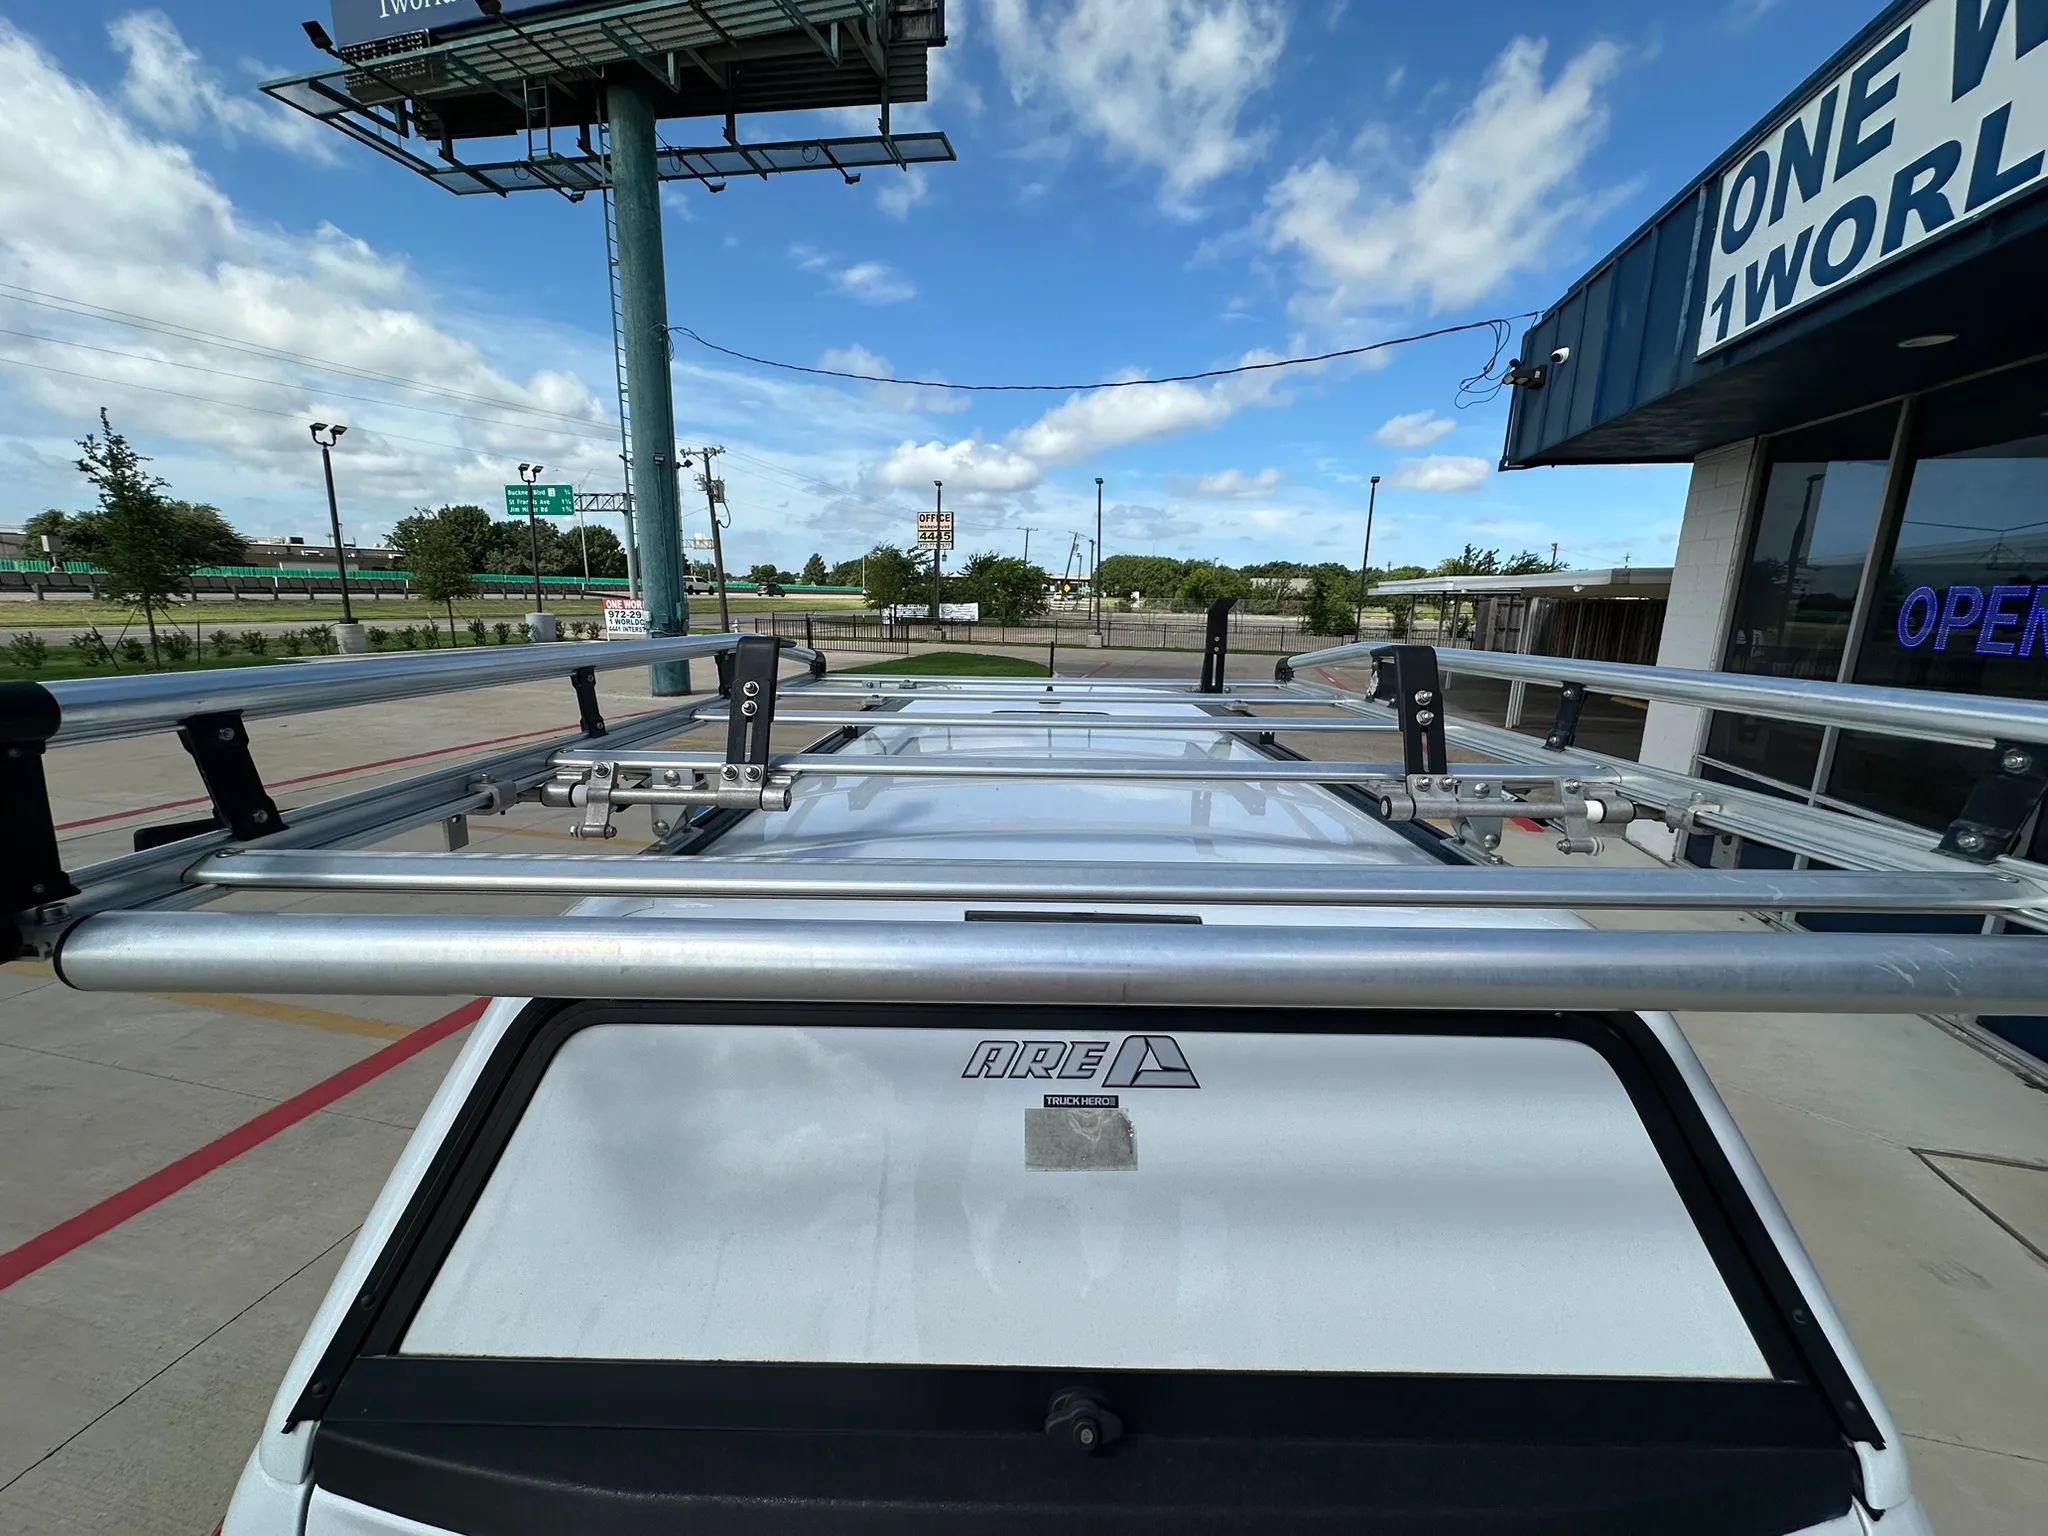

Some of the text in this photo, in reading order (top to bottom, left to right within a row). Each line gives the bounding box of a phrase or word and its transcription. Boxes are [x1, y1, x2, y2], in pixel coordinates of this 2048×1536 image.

[1720, 23, 1913, 256] ONE
[1710, 101, 2046, 343] 1WORL
[919, 513, 950, 522] OFFICE
[919, 531, 951, 540] 4445
[605, 599, 644, 609] ONE WOR
[1046, 1096, 1110, 1106] TRUCK HERO
